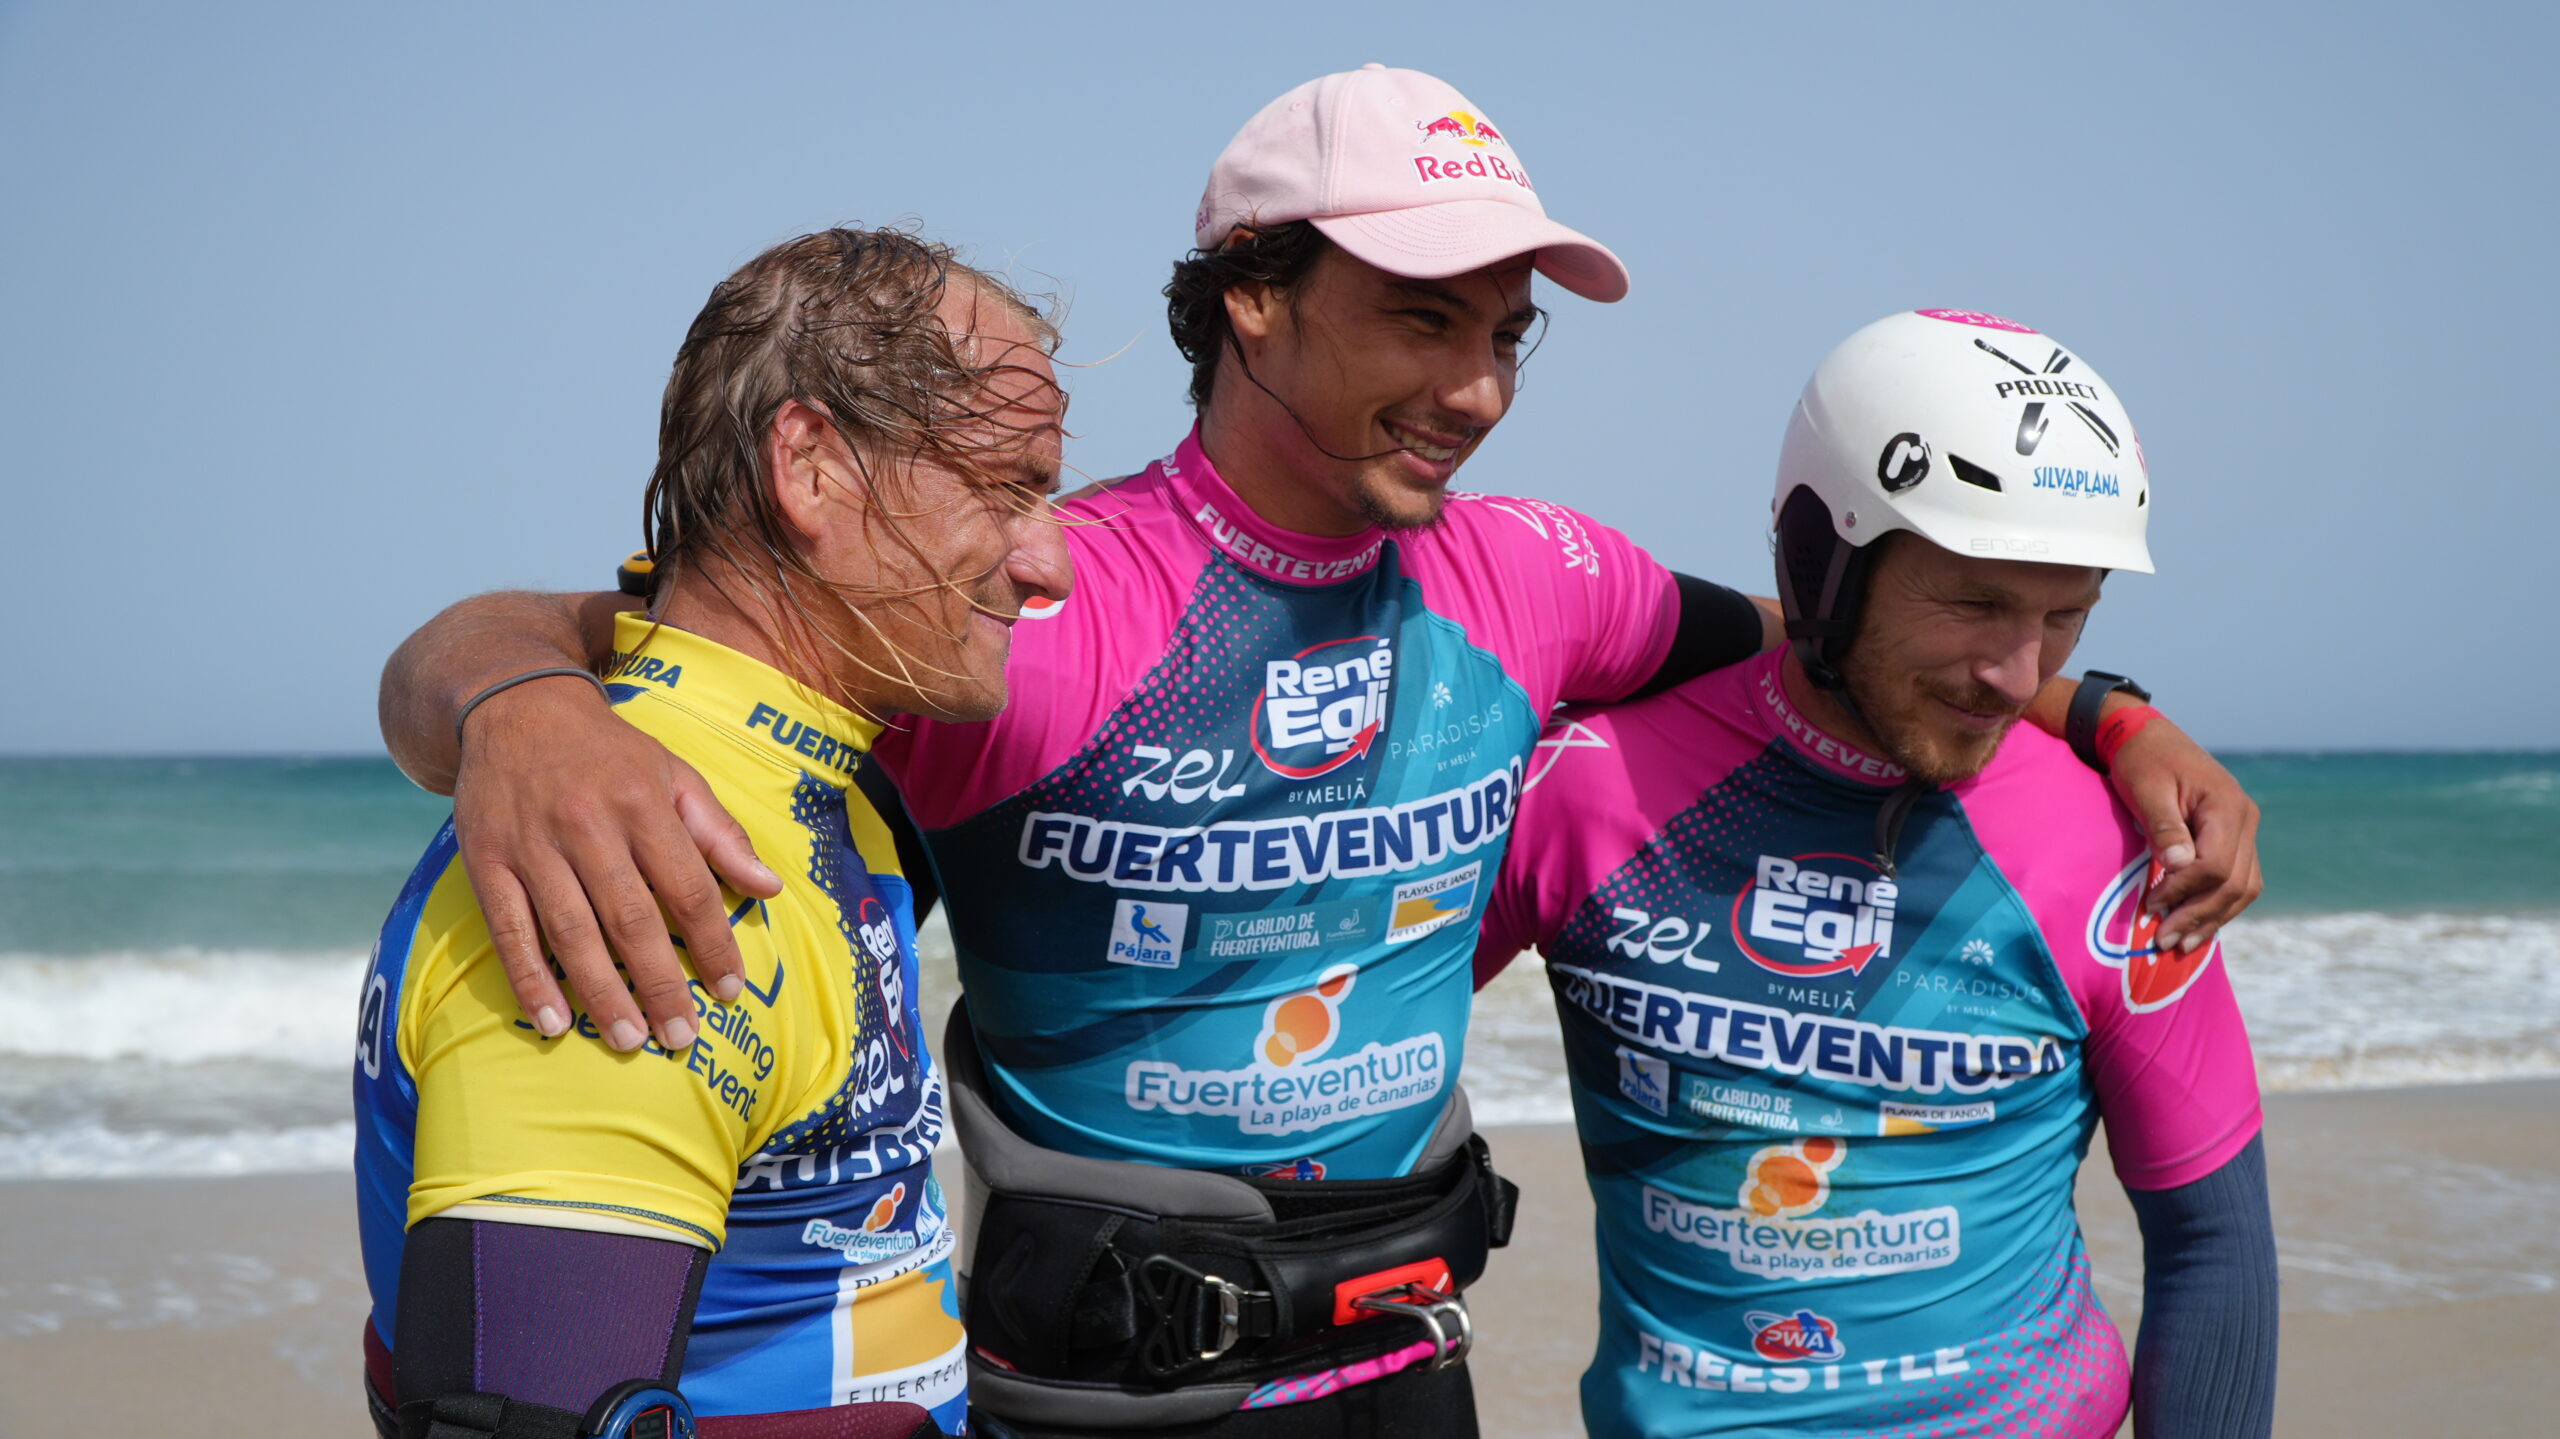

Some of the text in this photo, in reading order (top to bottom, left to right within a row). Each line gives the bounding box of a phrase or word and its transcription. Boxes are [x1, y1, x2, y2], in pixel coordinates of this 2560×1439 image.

[1414, 152, 1534, 191] Red Bul
[1994, 379, 2099, 401] PROJECT
[2033, 466, 2120, 497] SILVAPLANA
[1266, 638, 1392, 698] René
[1266, 679, 1390, 755] Egli
[1391, 703, 1503, 760] PARADISUS
[1759, 671, 1907, 779] FUERTEVEN
[745, 702, 864, 774] FUERTE
[1437, 760, 1448, 772] BY
[1288, 790, 1304, 803] BY
[1023, 759, 1523, 886] FUERTEVENTURA
[1398, 883, 1434, 900] PLAYAS
[1436, 877, 1449, 891] DE
[1756, 854, 1898, 908] René
[859, 909, 898, 965] Ren
[1236, 912, 1316, 938] CABILDO DE
[1751, 888, 1896, 961] Egli
[1114, 940, 1172, 963] Pájara
[1210, 930, 1320, 957] FUERTEVENTURA
[1768, 982, 1783, 995] BY
[1896, 970, 2044, 1004] PARADISUS
[687, 1036, 758, 1122] Event
[1137, 1041, 1438, 1106] Fuerteventura
[1250, 1076, 1437, 1127] La playa de Canarias
[1690, 1099, 1799, 1132] FUERTEVENTURA
[1712, 1085, 1793, 1115] CABILDO DE
[1885, 1106, 1928, 1118] PLAYAS
[1931, 1110, 1946, 1120] DE
[1651, 1193, 1950, 1251] Fuerteventura
[860, 1250, 881, 1261] playa
[1740, 1244, 1950, 1272] La playa de Canarias
[1765, 1329, 1825, 1349] PWA
